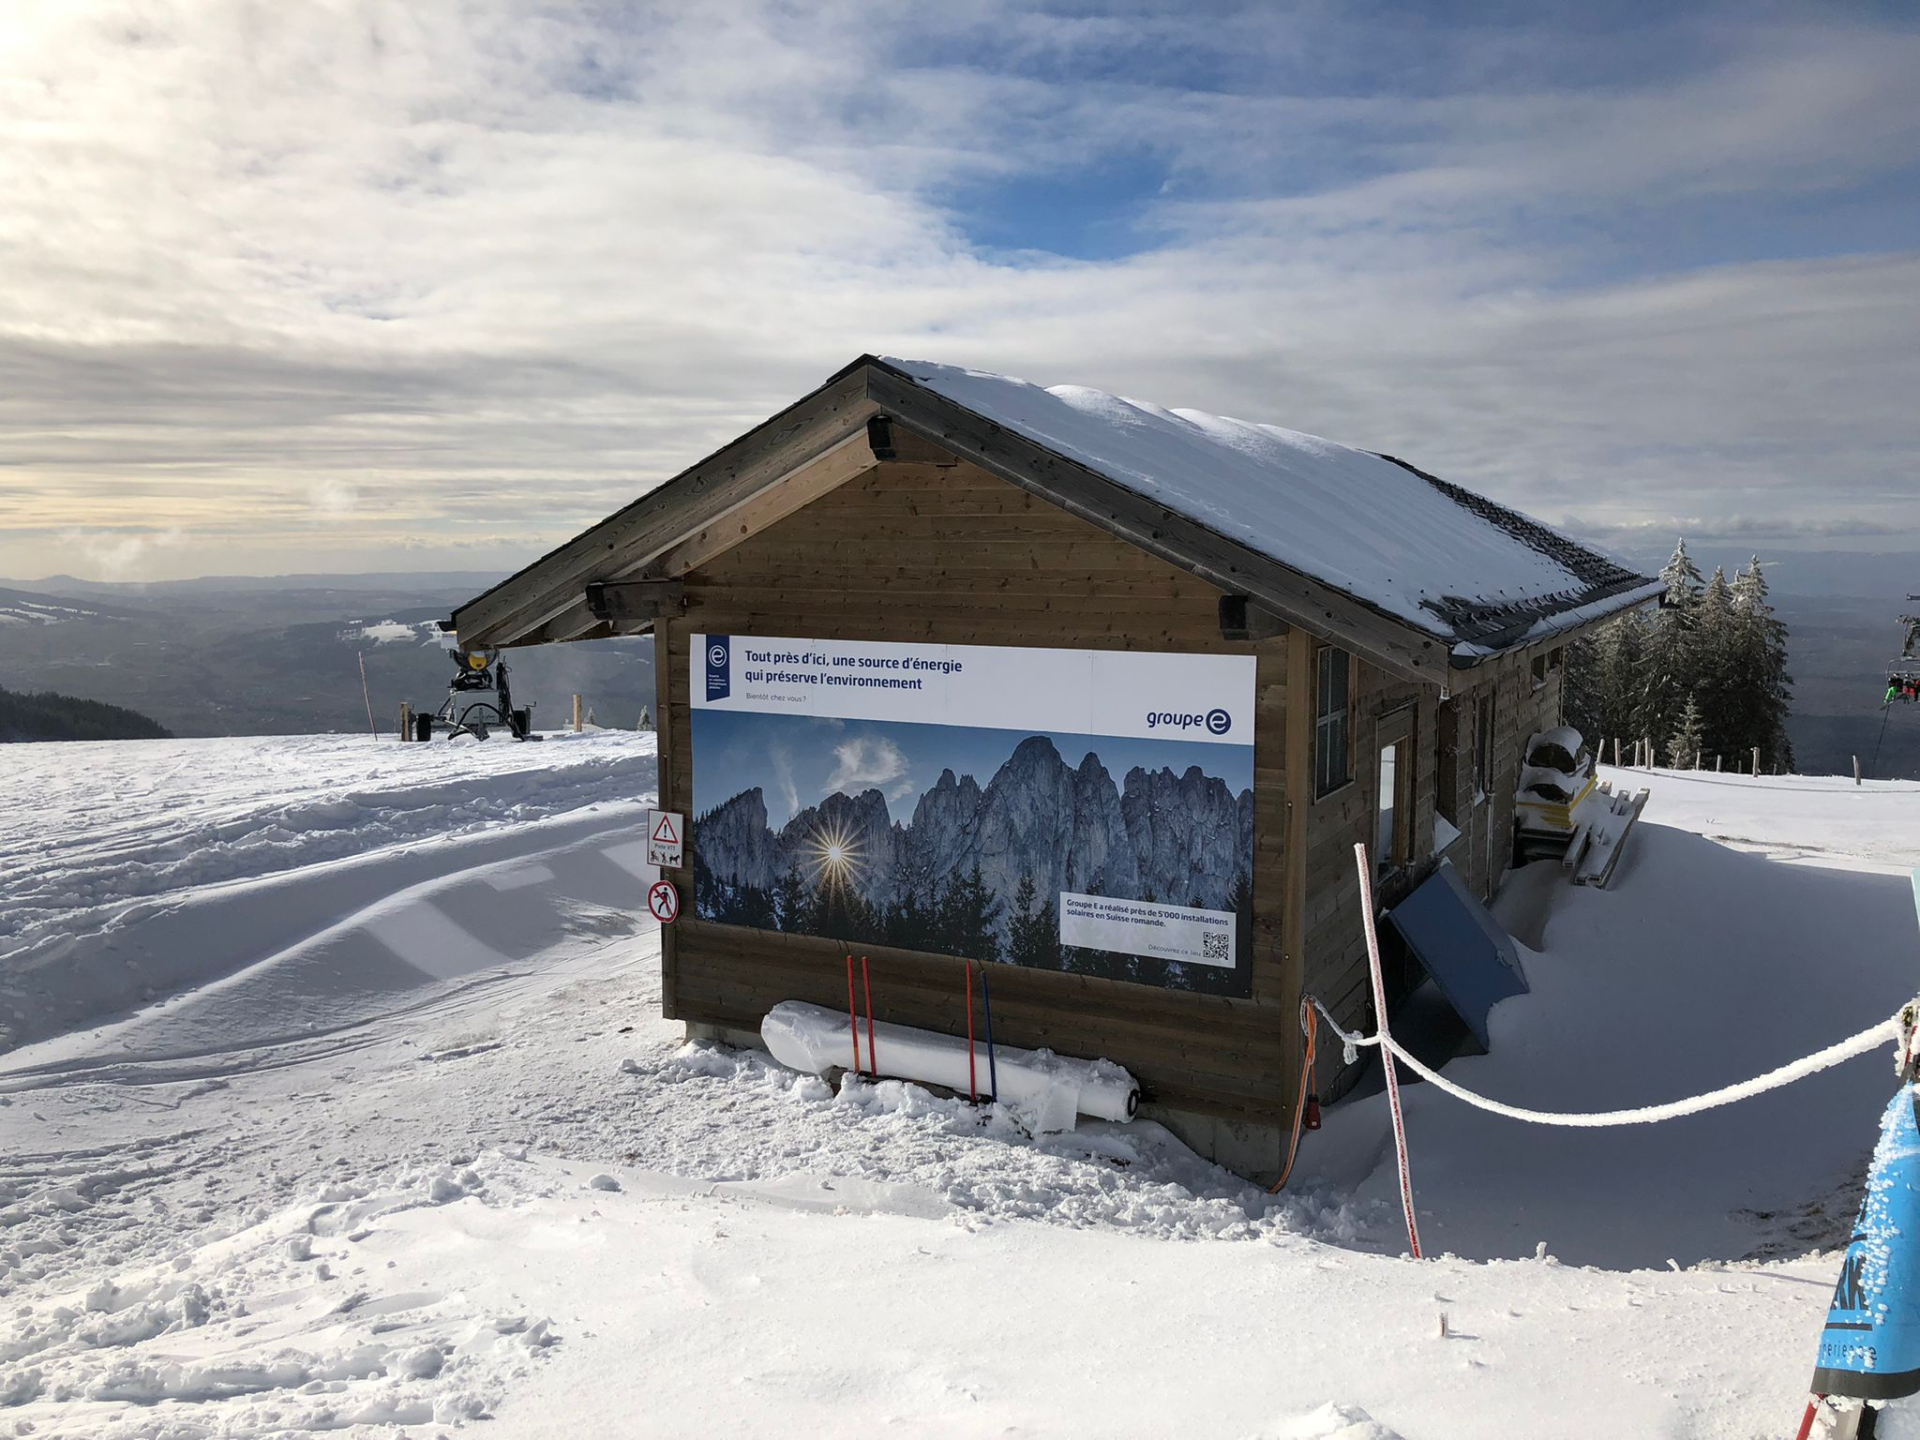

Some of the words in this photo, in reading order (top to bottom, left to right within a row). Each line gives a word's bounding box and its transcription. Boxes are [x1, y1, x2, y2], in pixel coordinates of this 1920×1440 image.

[745, 650, 772, 662] Tout
[774, 652, 800, 665] près
[833, 657, 856, 667] une
[858, 657, 900, 669] source
[902, 657, 963, 675] d'énergie
[745, 669, 764, 683] qui
[766, 670, 818, 685] préserve
[820, 672, 923, 690] l'environnement
[746, 692, 770, 701] Bientôt
[771, 694, 785, 702] chez
[1146, 711, 1204, 730] groupe
[1066, 899, 1093, 909] Groupe
[1093, 902, 1099, 910] E
[1104, 904, 1129, 914] réalisé
[1130, 907, 1147, 916] près
[1147, 909, 1157, 918] de
[1181, 913, 1229, 926] installations
[1066, 908, 1095, 919] solaires
[1106, 912, 1130, 923] Suisse
[1131, 916, 1167, 928] romande.
[1148, 944, 1180, 954] Découvrez
